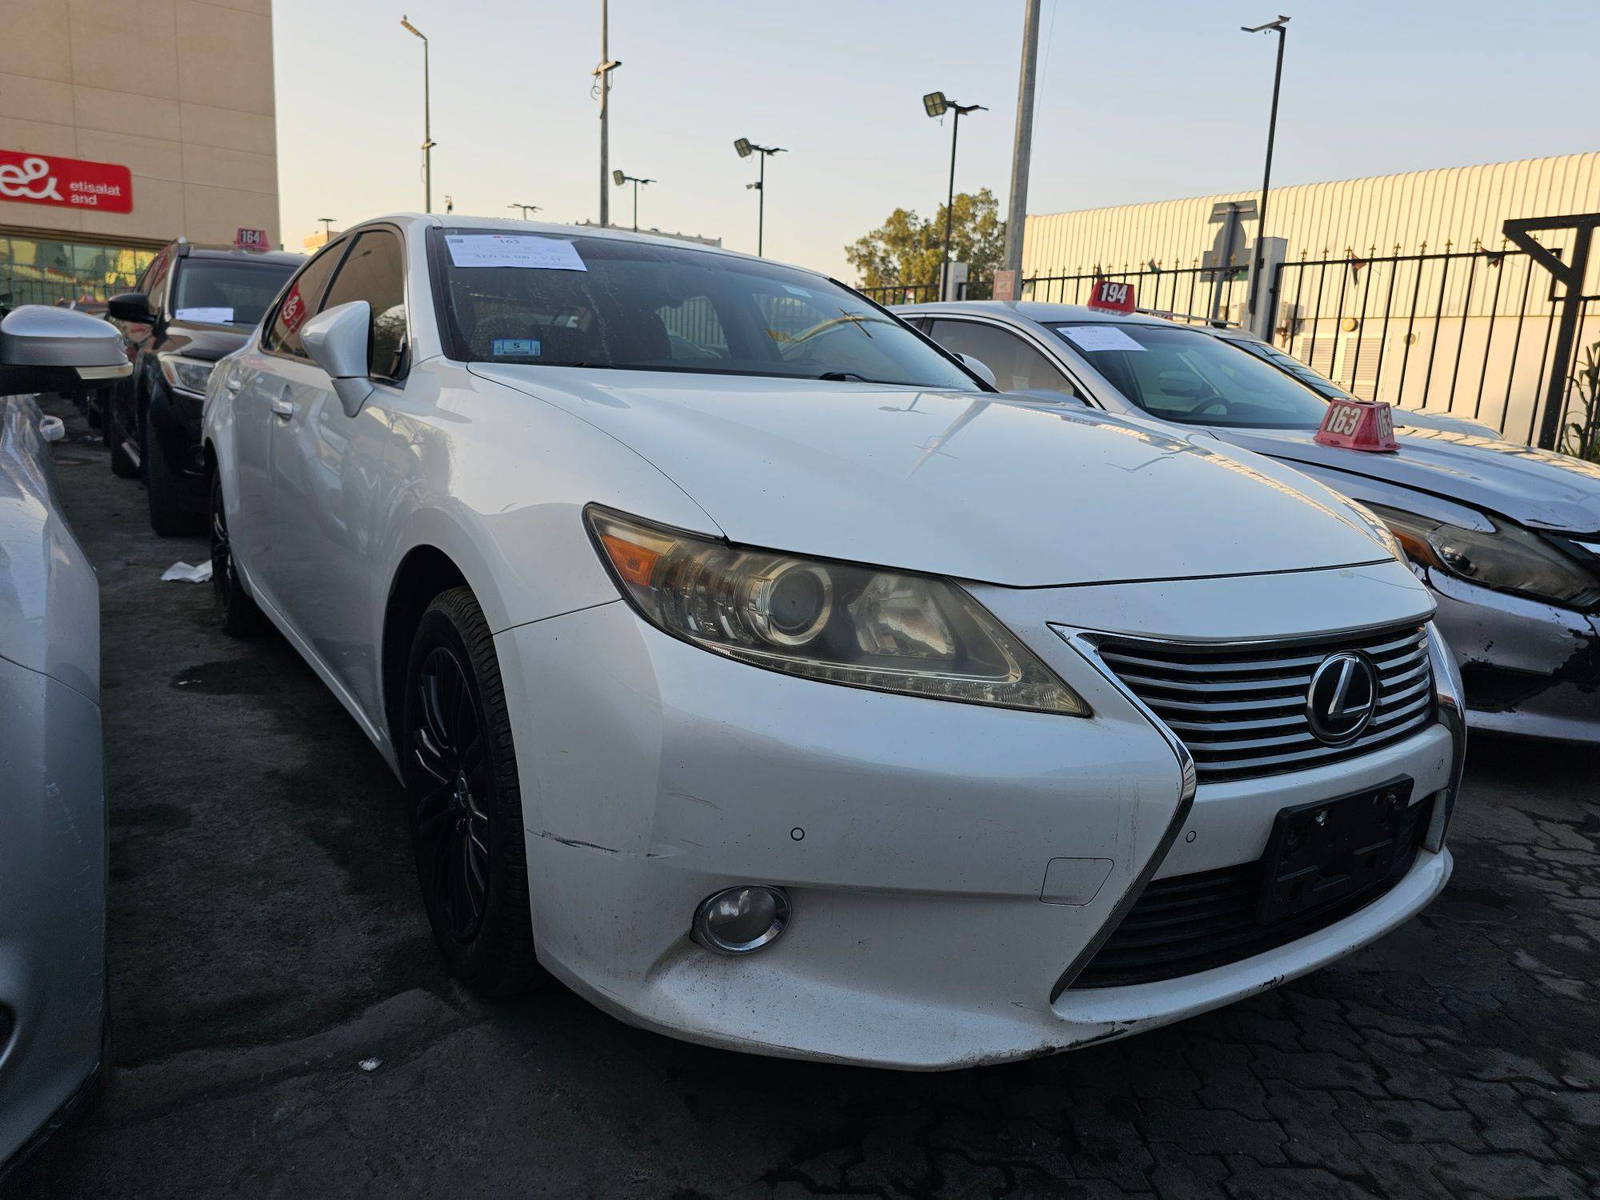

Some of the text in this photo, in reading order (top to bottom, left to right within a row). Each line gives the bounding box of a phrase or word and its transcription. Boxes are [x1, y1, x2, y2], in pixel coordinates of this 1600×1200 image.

[70, 181, 121, 196] etisalat
[70, 194, 97, 206] and
[242, 230, 260, 243] 164
[1101, 283, 1128, 304] 194
[1326, 405, 1361, 435] 163
